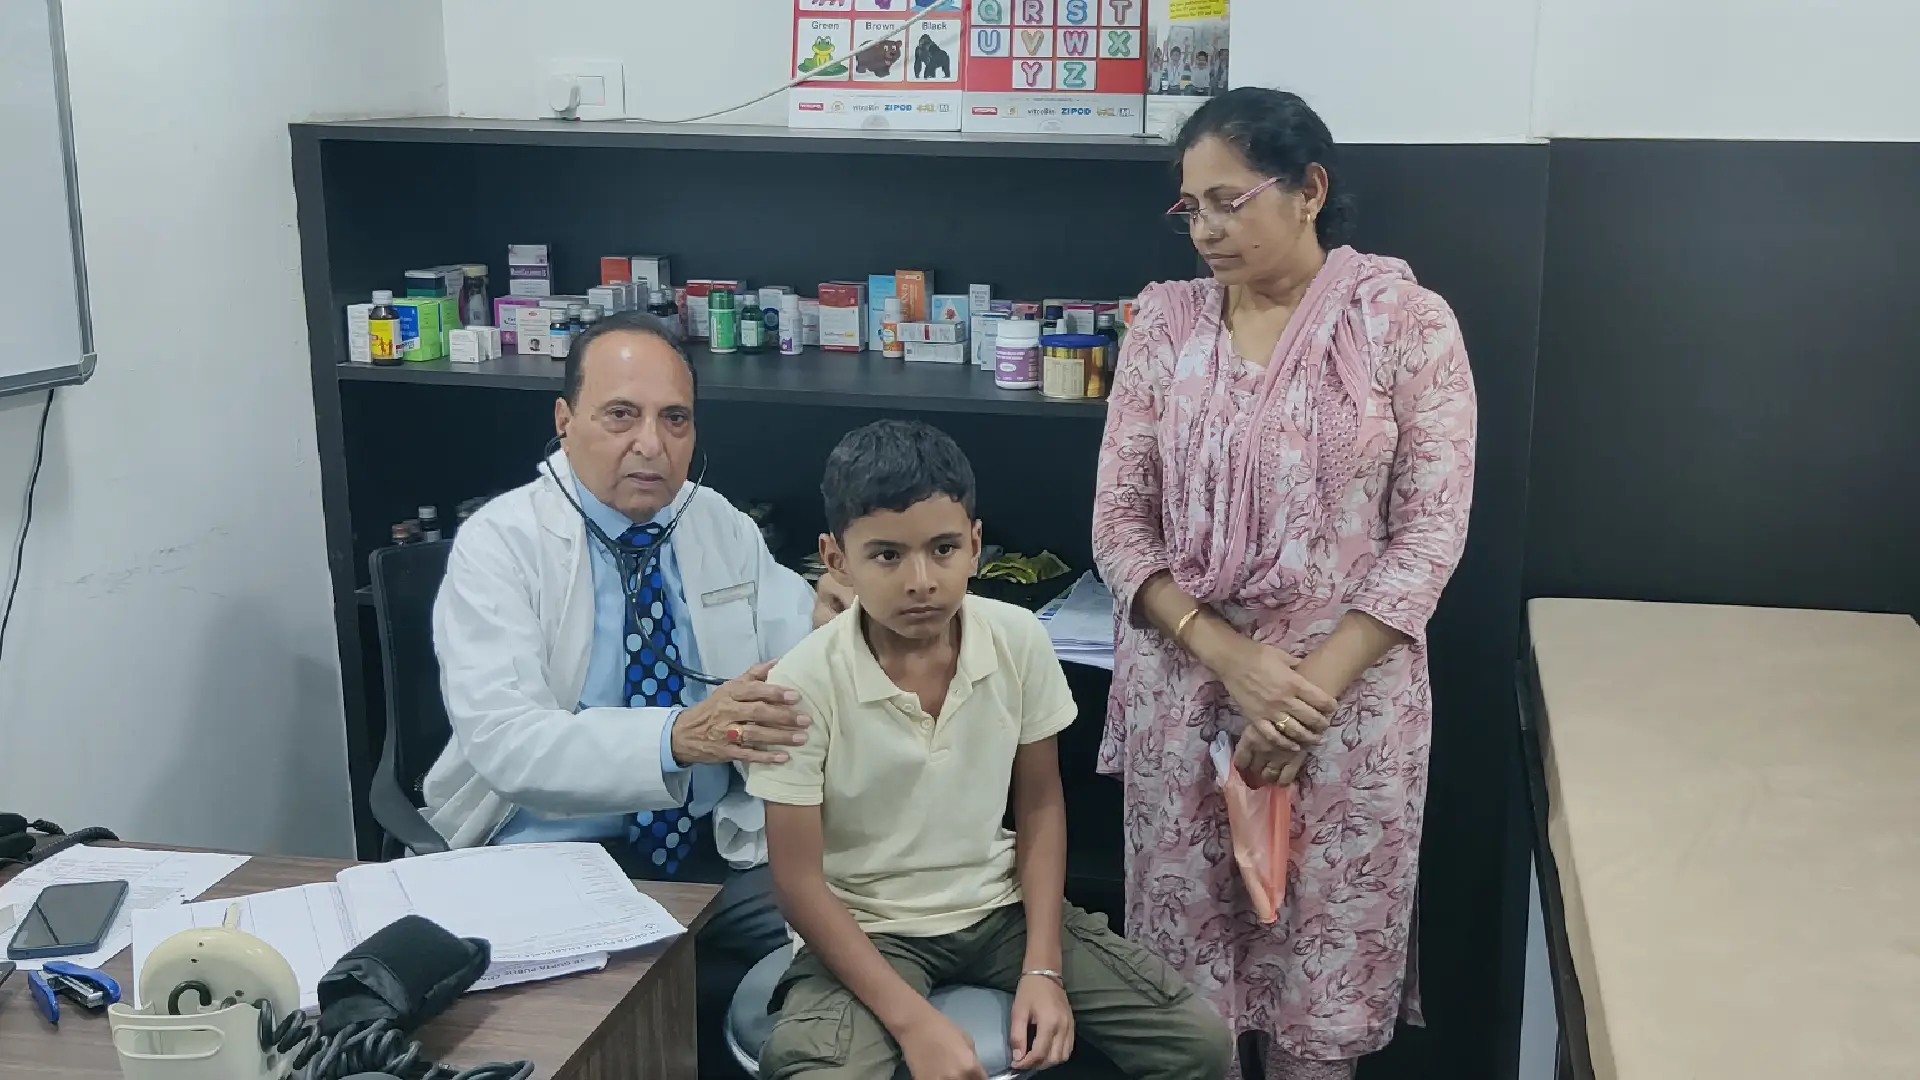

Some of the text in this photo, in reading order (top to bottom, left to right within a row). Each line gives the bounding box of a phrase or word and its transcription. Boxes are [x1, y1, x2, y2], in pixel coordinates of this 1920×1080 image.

[811, 20, 948, 31] Green Brown Black
[977, 0, 1133, 25] Q R S T
[977, 29, 1132, 57] U V W X
[1020, 61, 1087, 88] Y Z
